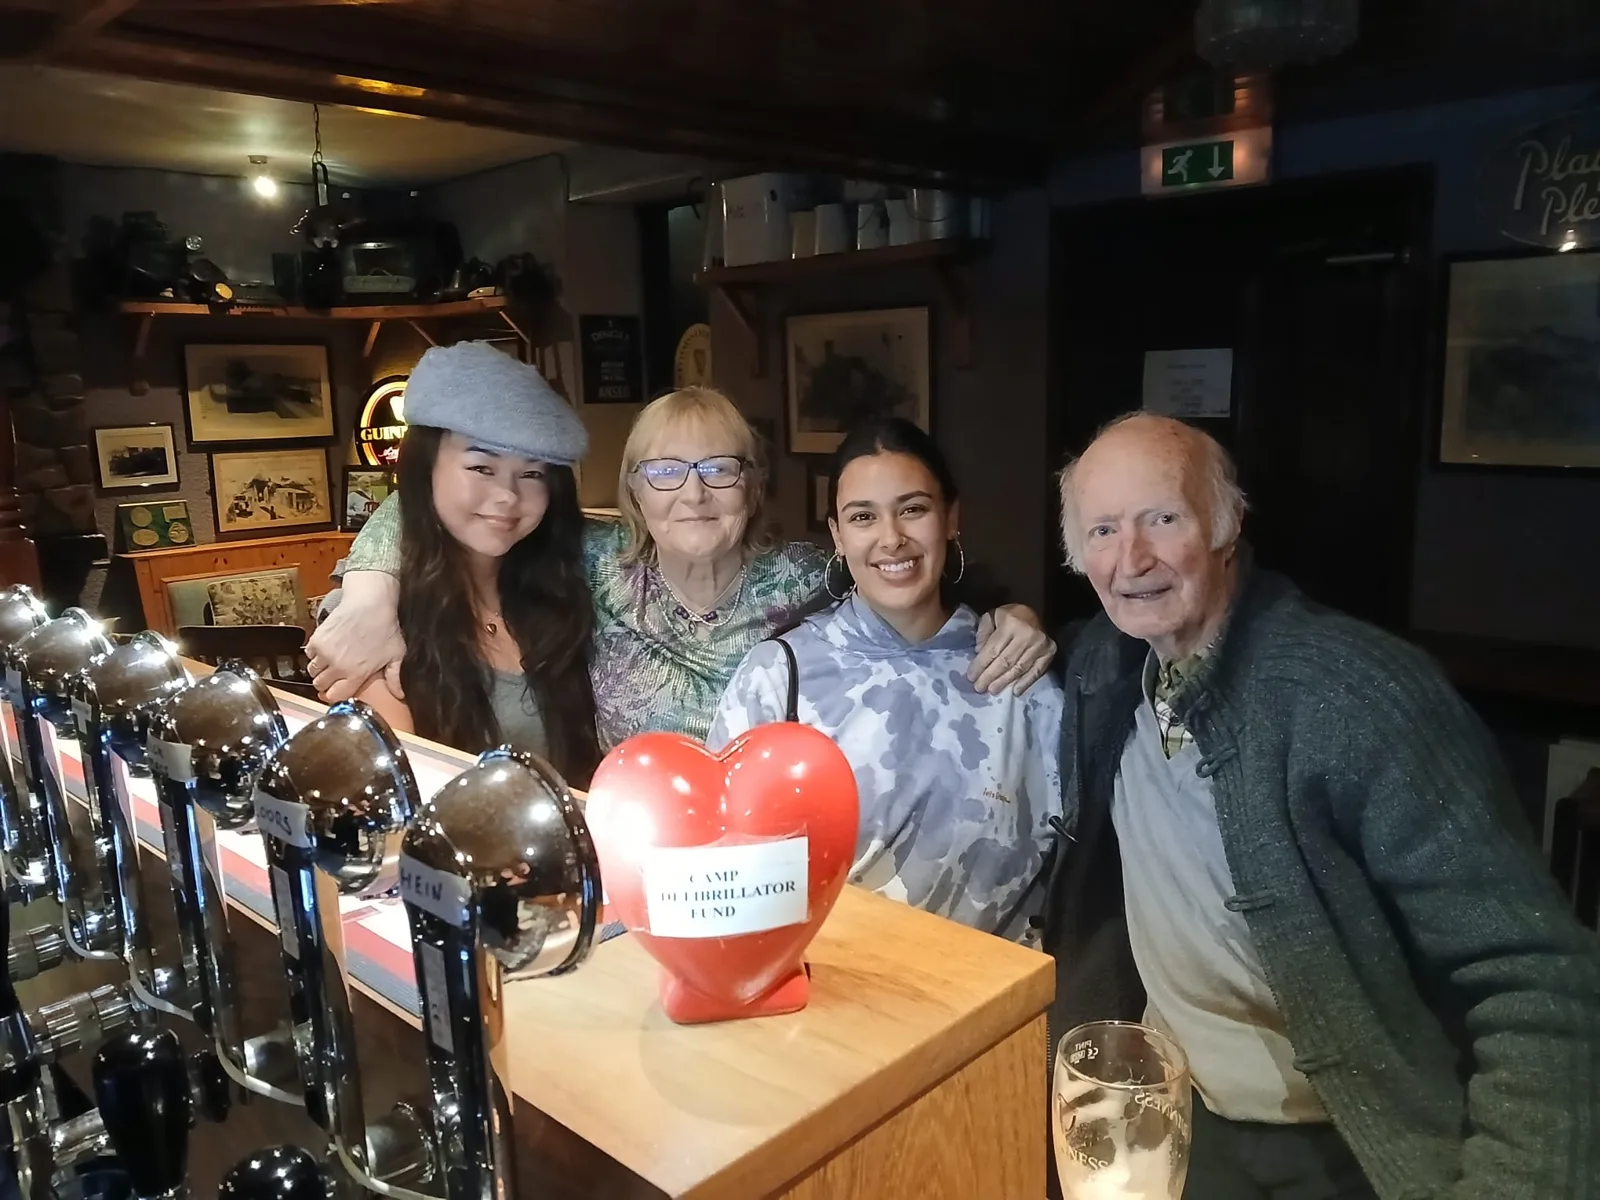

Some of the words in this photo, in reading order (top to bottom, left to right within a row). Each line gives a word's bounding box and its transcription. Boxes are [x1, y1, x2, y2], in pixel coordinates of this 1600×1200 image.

[361, 425, 408, 441] GUIN
[257, 806, 292, 836] OORS
[689, 870, 739, 884] CAMP
[690, 904, 736, 919] FUND
